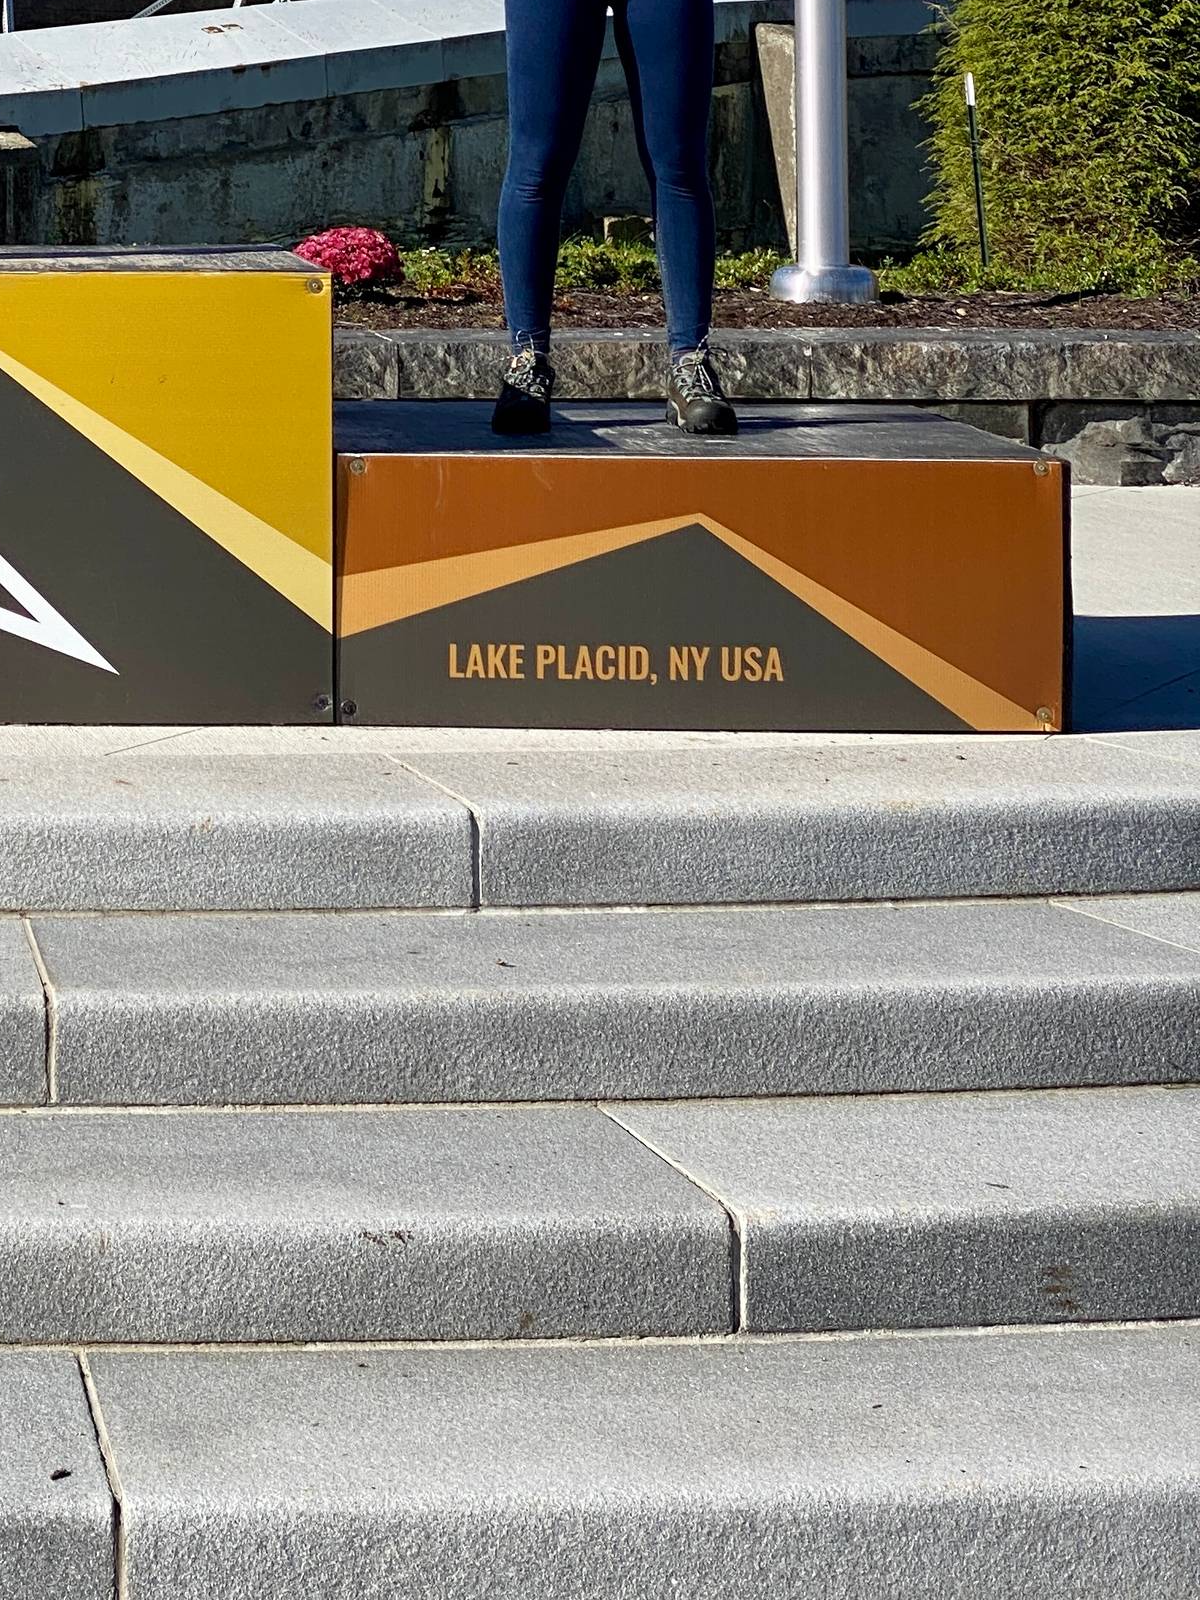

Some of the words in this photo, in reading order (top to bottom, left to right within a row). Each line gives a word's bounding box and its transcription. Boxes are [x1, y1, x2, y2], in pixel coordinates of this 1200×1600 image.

[448, 643, 525, 679] LAKE
[536, 644, 658, 685] PLACID,
[669, 646, 709, 681] NY
[720, 647, 785, 682] USA
